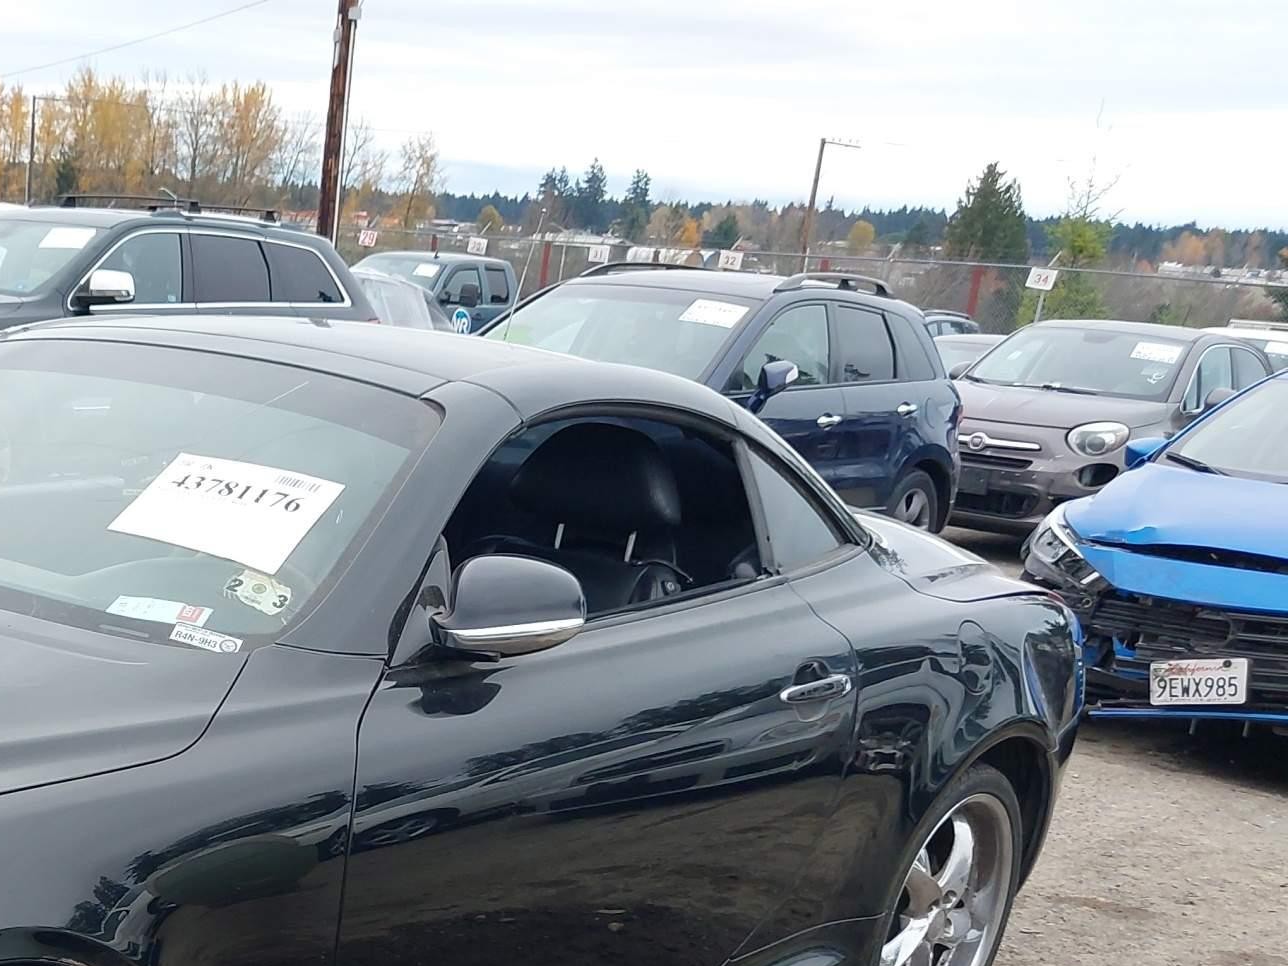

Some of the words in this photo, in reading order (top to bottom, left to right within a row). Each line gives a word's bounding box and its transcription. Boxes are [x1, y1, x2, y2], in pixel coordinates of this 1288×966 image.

[362, 231, 375, 245] 29
[724, 255, 736, 266] 32
[1034, 273, 1049, 286] 34
[171, 474, 304, 512] 43781176
[226, 579, 244, 592] 2
[272, 594, 288, 608] 3
[1164, 663, 1223, 676] California
[1157, 676, 1238, 698] 9EWX985
